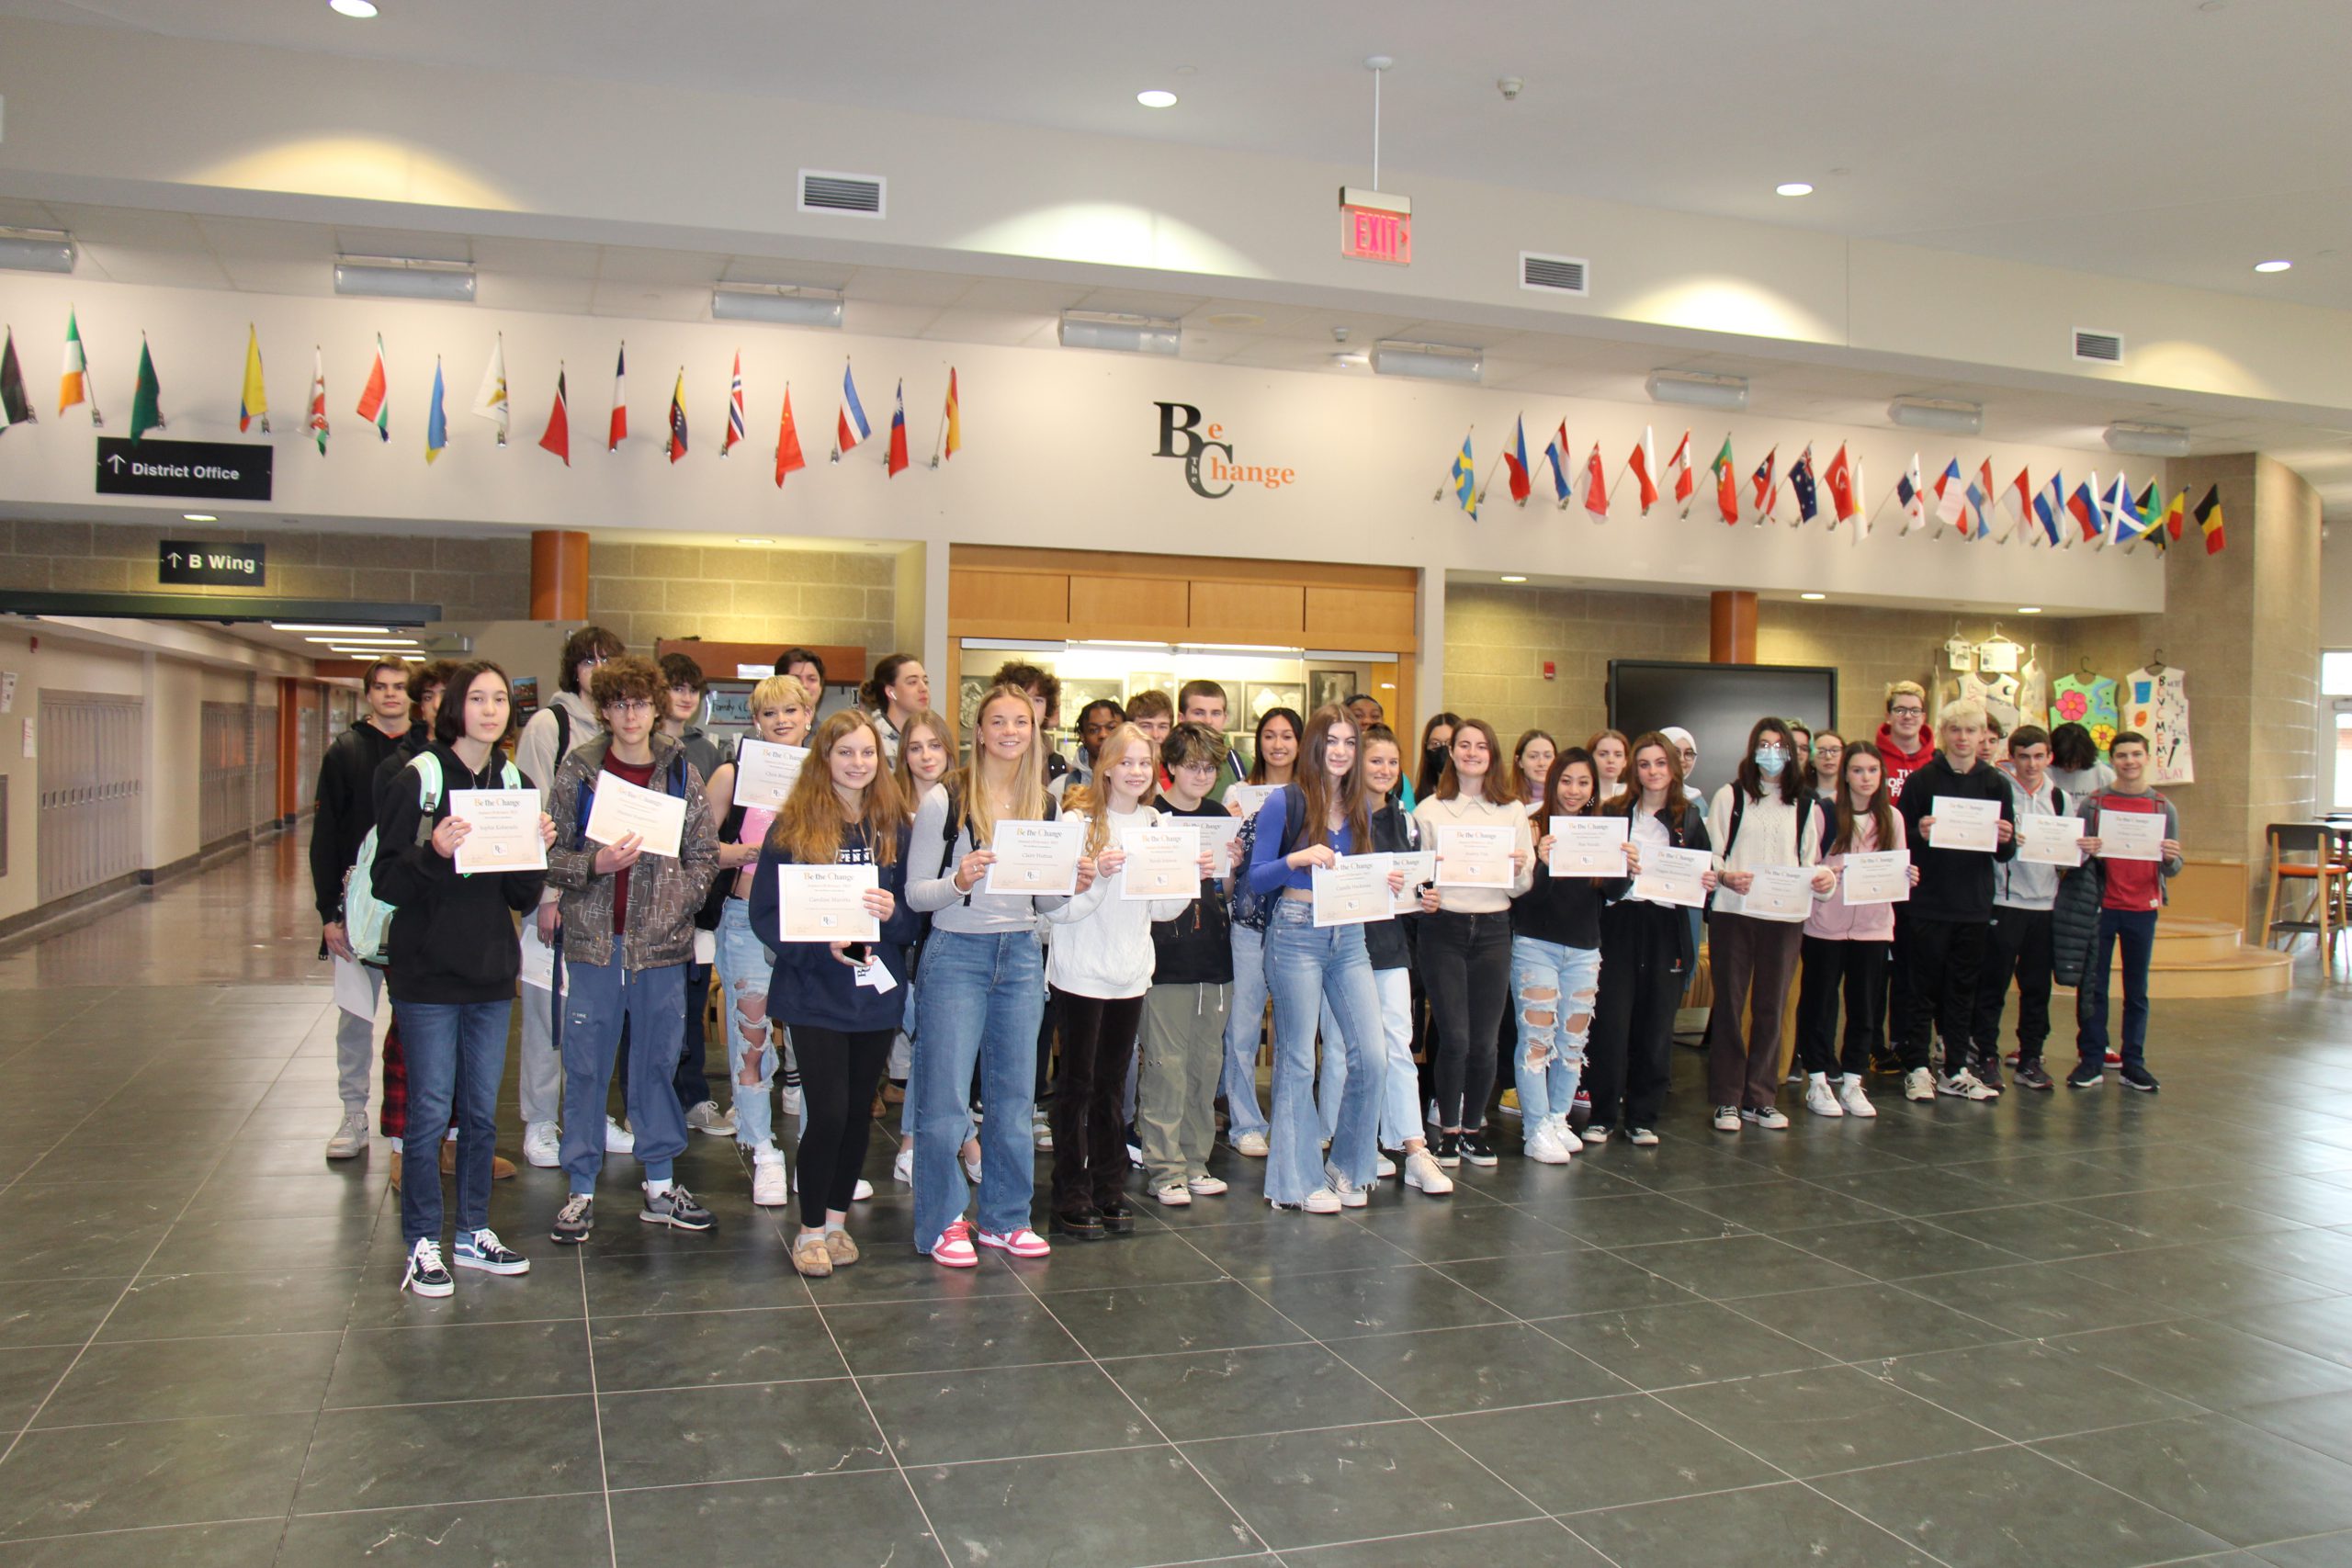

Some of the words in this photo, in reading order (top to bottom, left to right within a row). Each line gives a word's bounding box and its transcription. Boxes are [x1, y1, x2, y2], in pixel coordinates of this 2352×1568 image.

[1354, 211, 1400, 258] EXIT
[131, 462, 189, 478] District
[193, 465, 240, 479] Office
[188, 554, 202, 569] B
[209, 554, 255, 573] Wing
